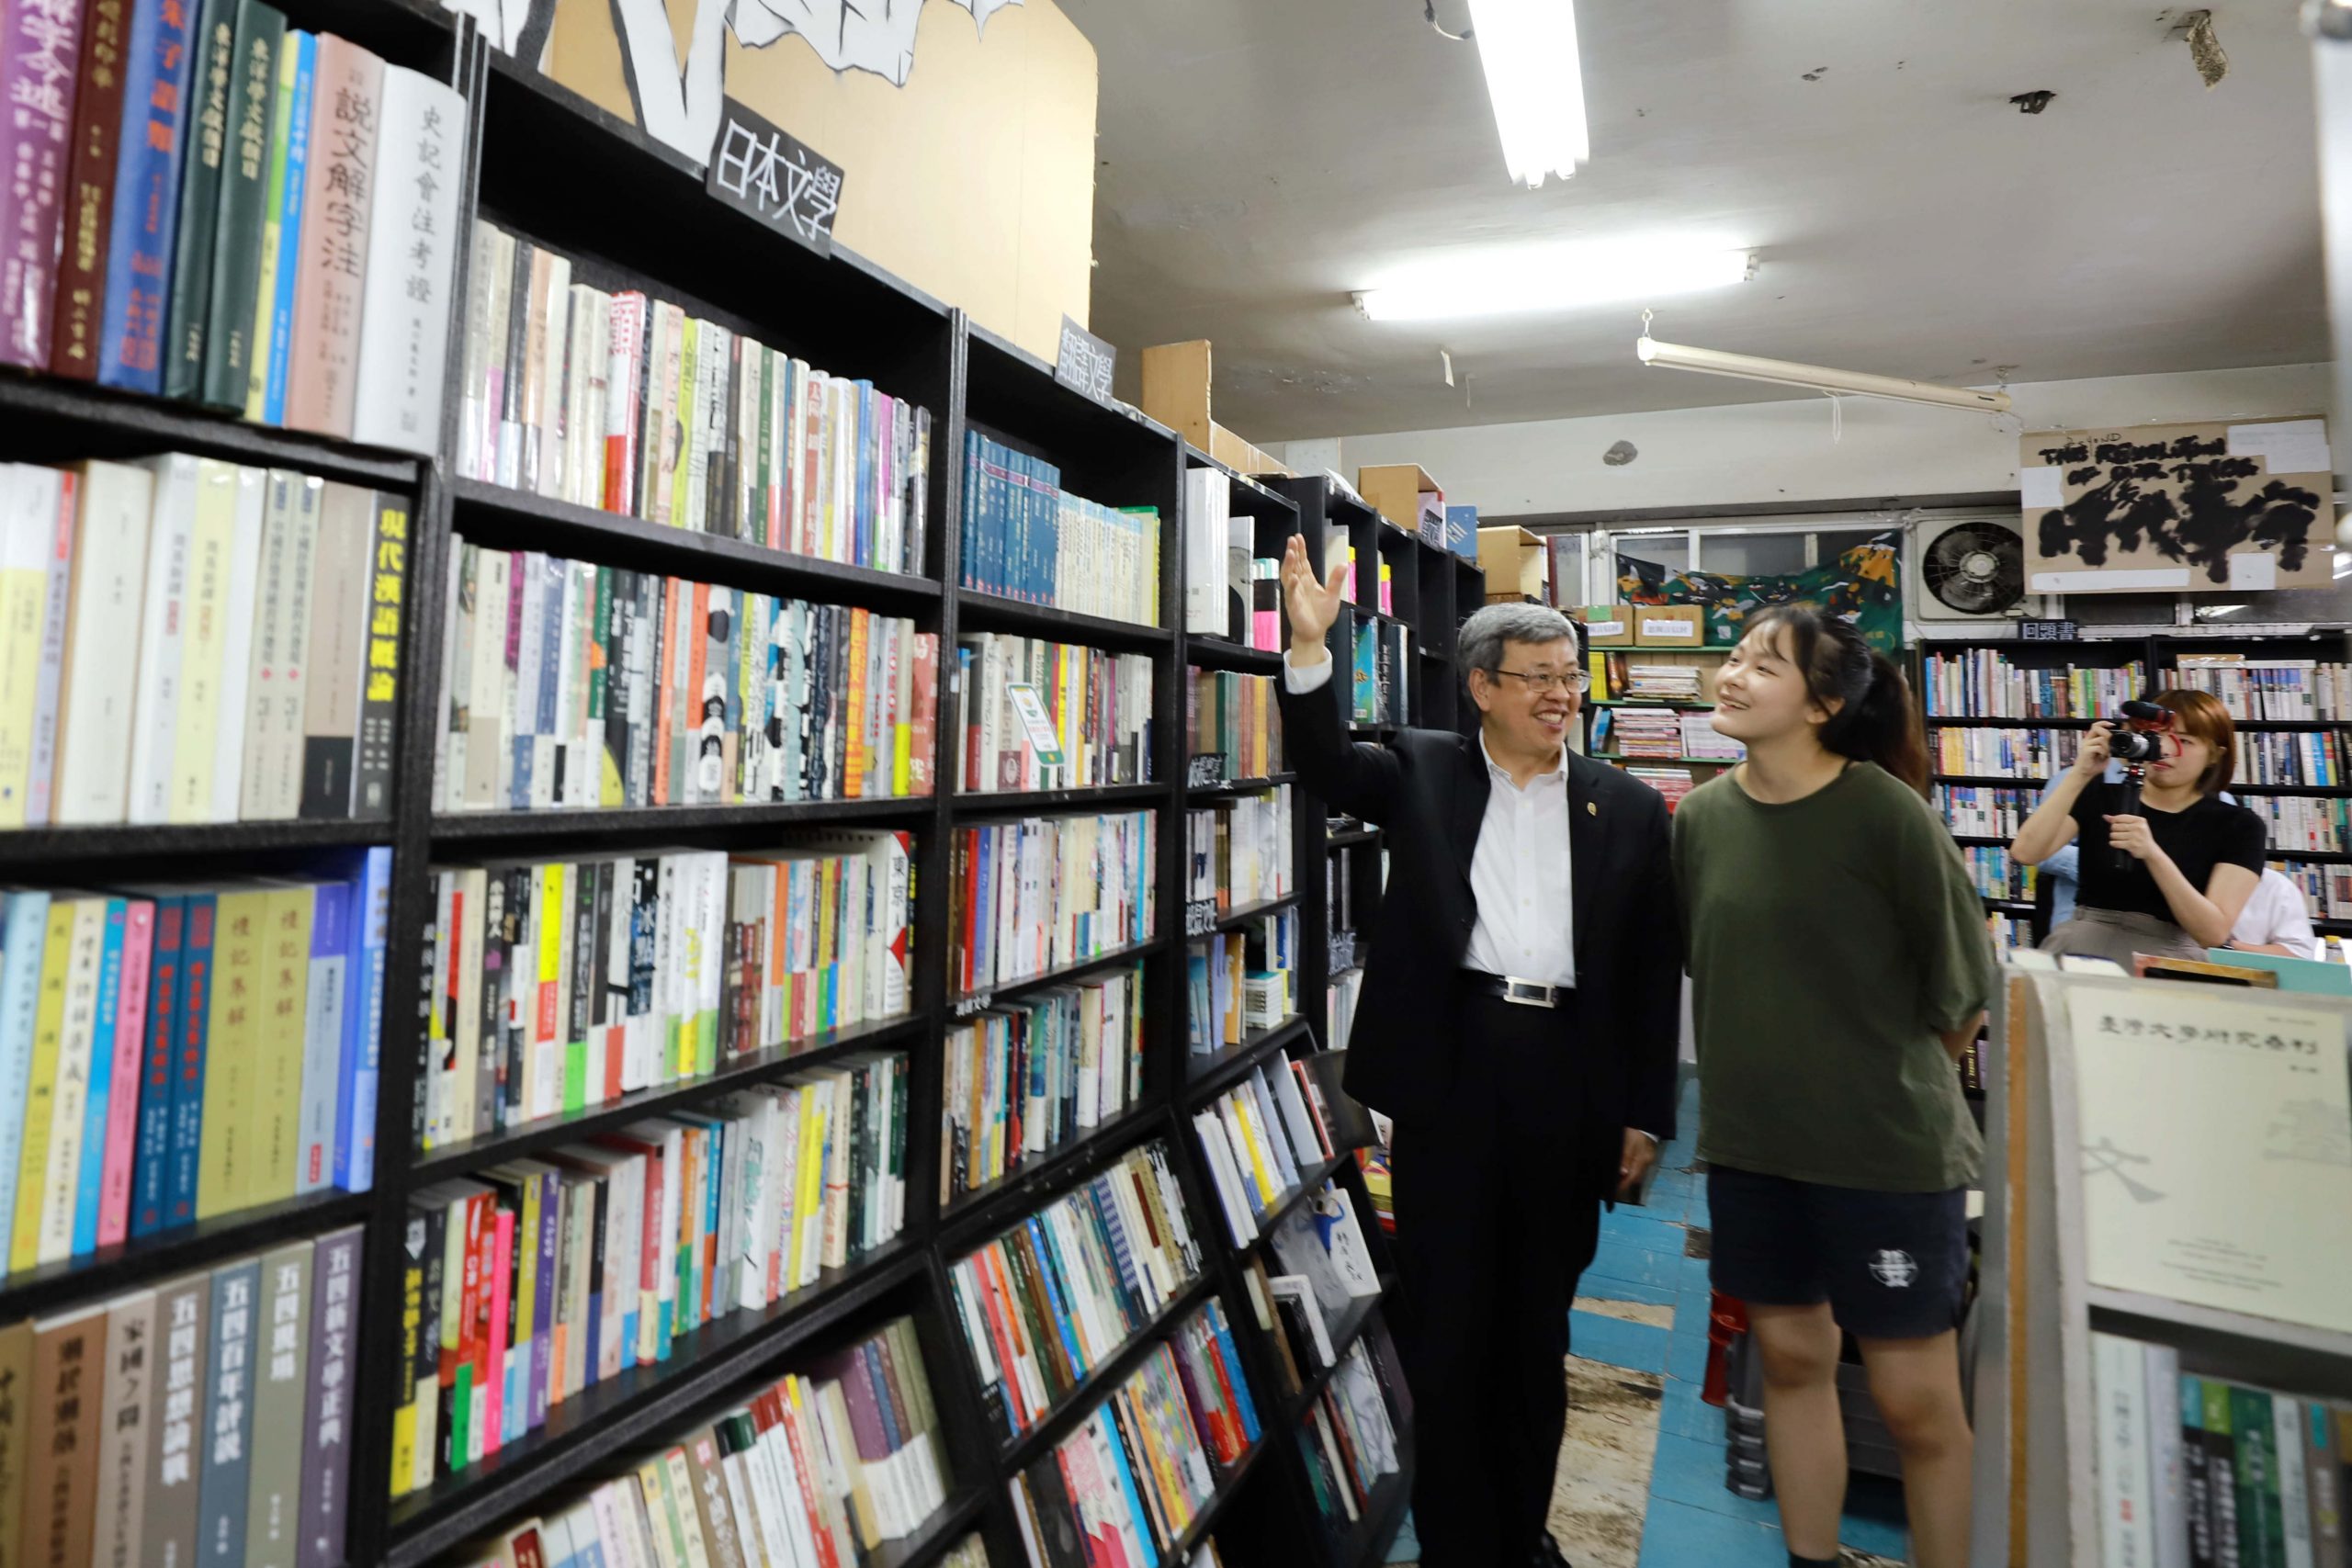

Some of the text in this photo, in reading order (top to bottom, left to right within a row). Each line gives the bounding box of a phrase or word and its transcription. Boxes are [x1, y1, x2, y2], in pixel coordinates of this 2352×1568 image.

[406, 106, 443, 305] 史記會注考證
[717, 118, 842, 242] 日本文學
[2022, 622, 2075, 640] 回頭書
